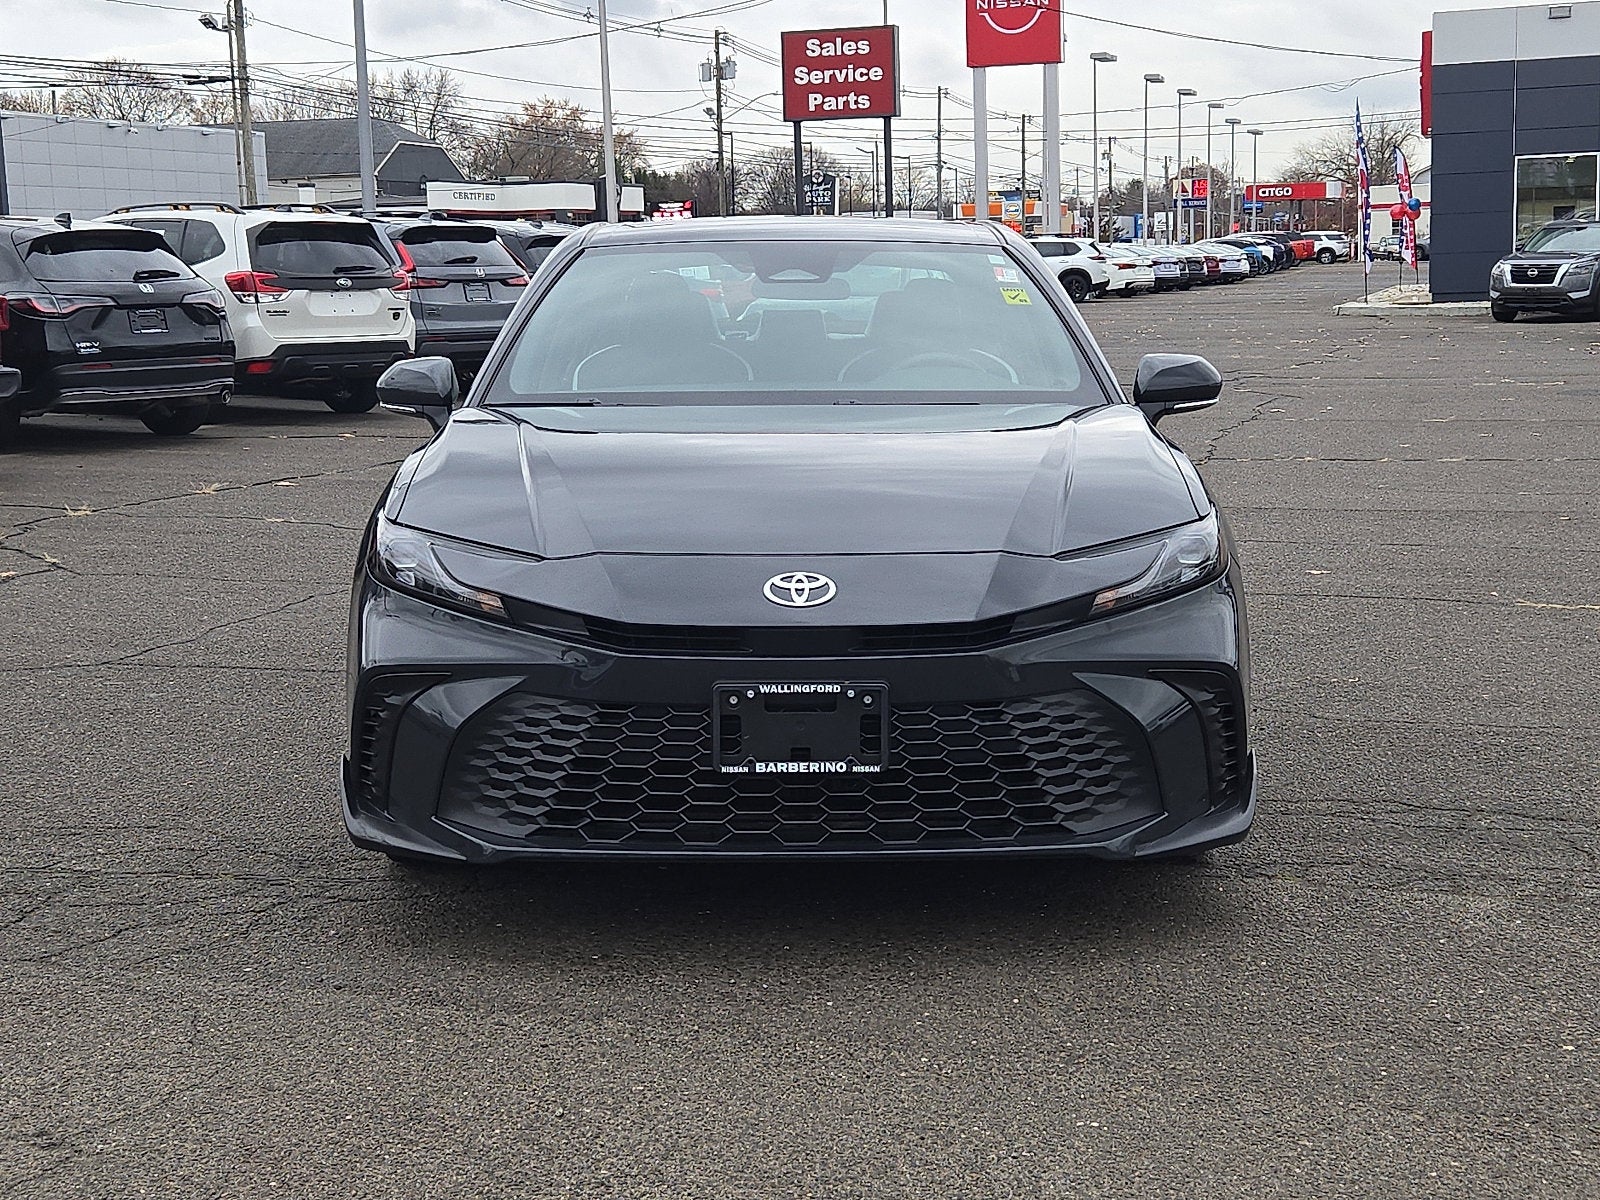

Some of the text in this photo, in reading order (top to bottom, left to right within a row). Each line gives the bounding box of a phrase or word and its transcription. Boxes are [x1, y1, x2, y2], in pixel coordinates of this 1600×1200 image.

[805, 37, 870, 57] Sales
[793, 64, 883, 85] Service
[808, 91, 871, 112] Parts
[452, 191, 496, 201] CERTIFIED
[1258, 187, 1292, 197] CITGO
[758, 684, 841, 693] WALLINGFORD
[755, 762, 847, 773] BARBERINO
[852, 765, 881, 773] NISSAN
